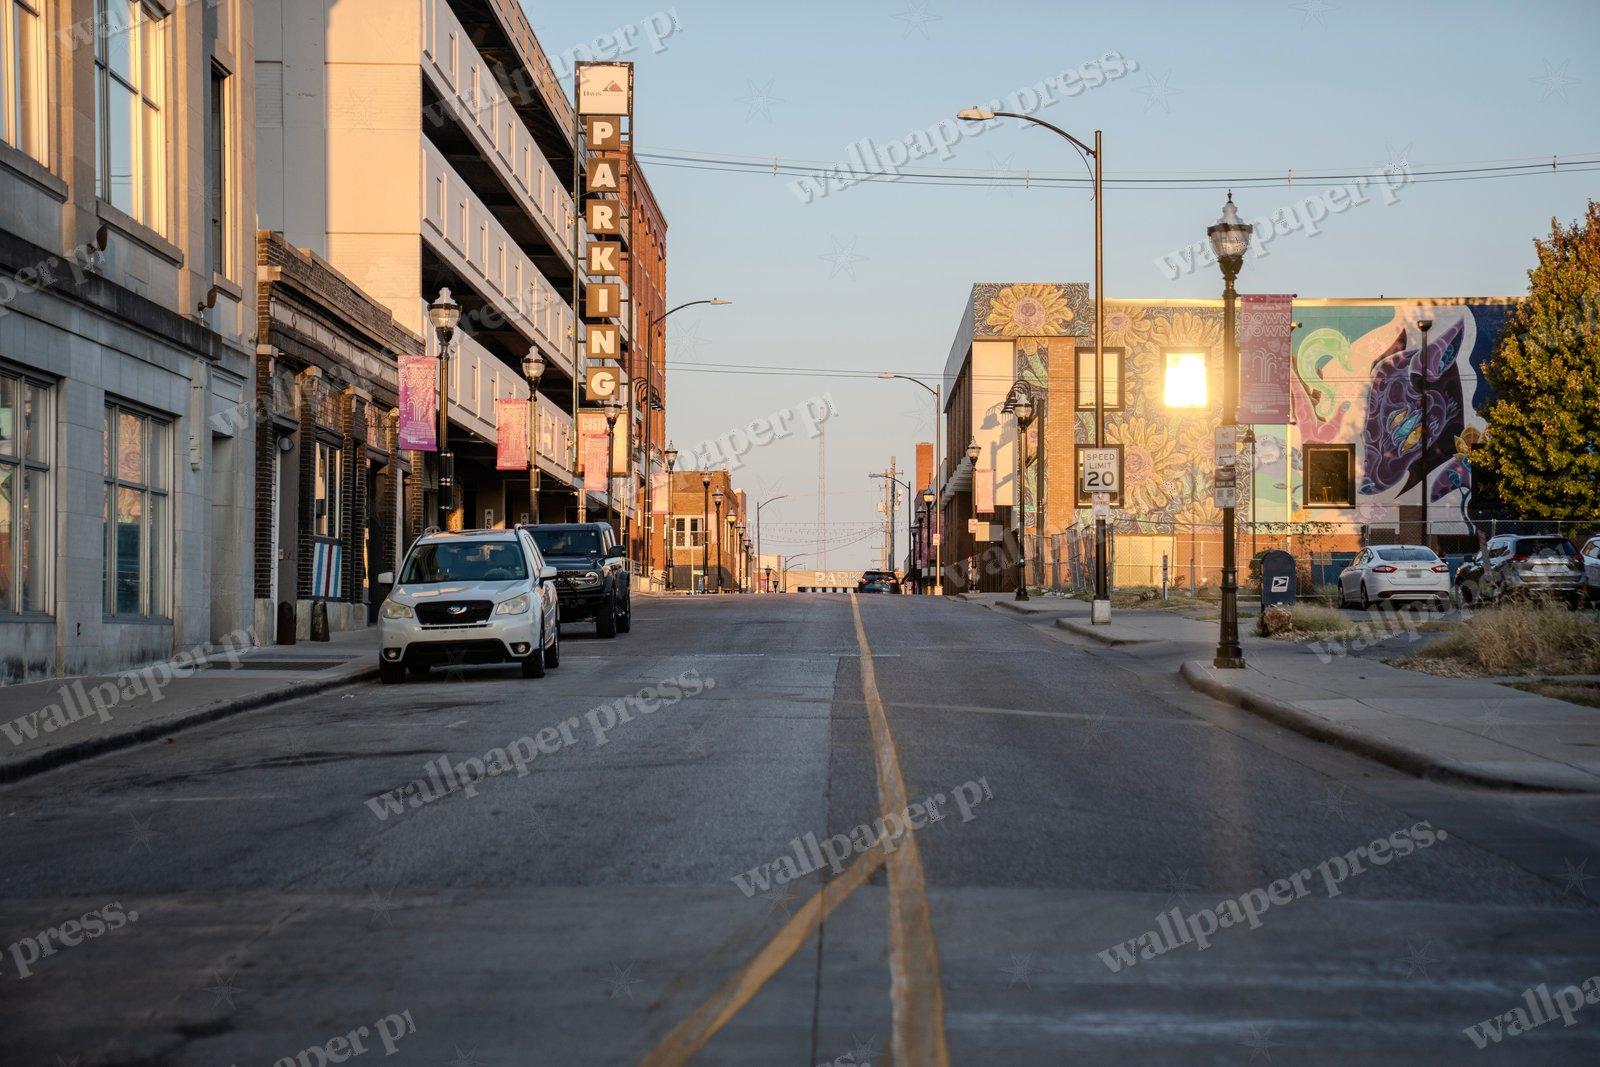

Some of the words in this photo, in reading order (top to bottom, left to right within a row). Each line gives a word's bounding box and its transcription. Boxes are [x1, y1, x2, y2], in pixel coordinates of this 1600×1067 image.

[590, 121, 617, 397] PARKING
[1242, 312, 1291, 325] DOWN
[1242, 325, 1291, 337] TOWN
[1086, 453, 1115, 461] SPEED
[1089, 462, 1112, 470] LIMIT
[1087, 471, 1115, 487] 20
